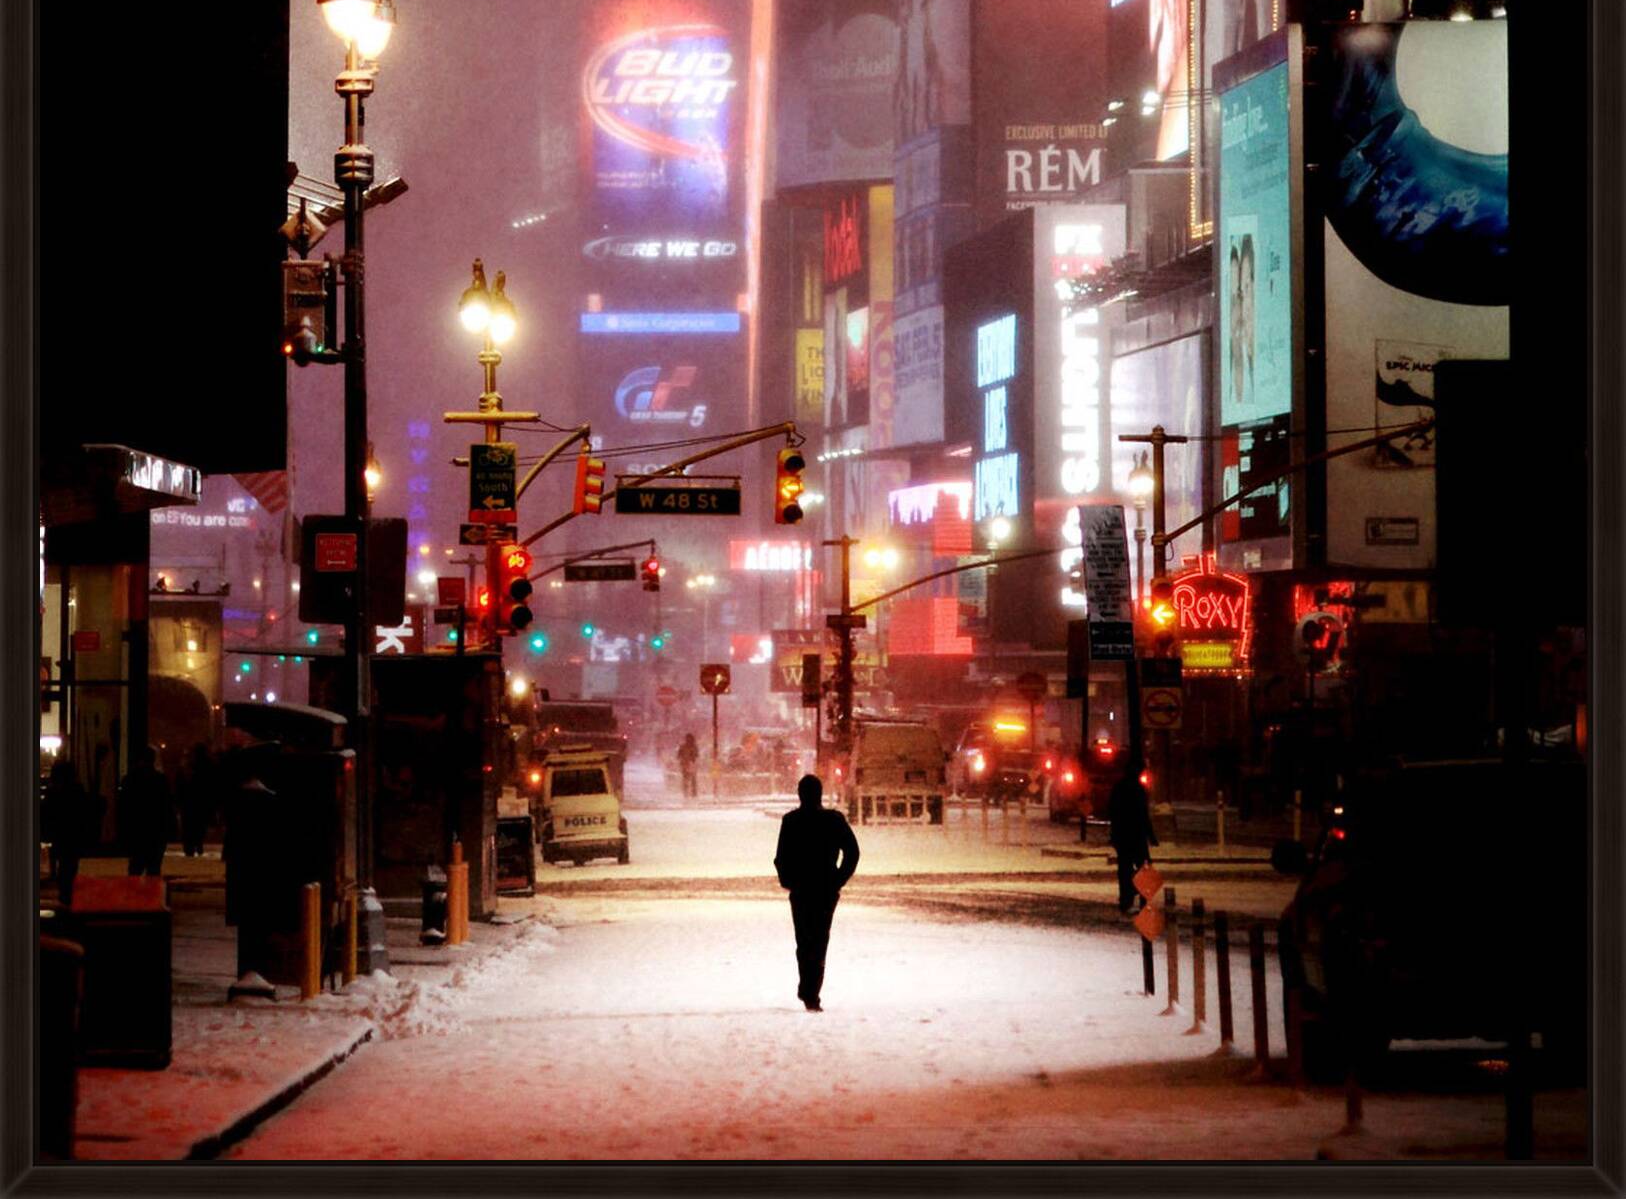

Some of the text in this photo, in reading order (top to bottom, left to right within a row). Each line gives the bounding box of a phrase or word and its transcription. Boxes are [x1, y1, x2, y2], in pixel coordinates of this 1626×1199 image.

[614, 48, 734, 77] BUD
[592, 78, 736, 104] LIGHT
[1006, 125, 1055, 140] EXCLUSIVE
[1057, 124, 1097, 139] LIMITED
[604, 241, 738, 258] HERE WE GO
[689, 404, 707, 427] 5
[639, 492, 720, 510] W 48 St
[564, 816, 608, 828] POLICE
